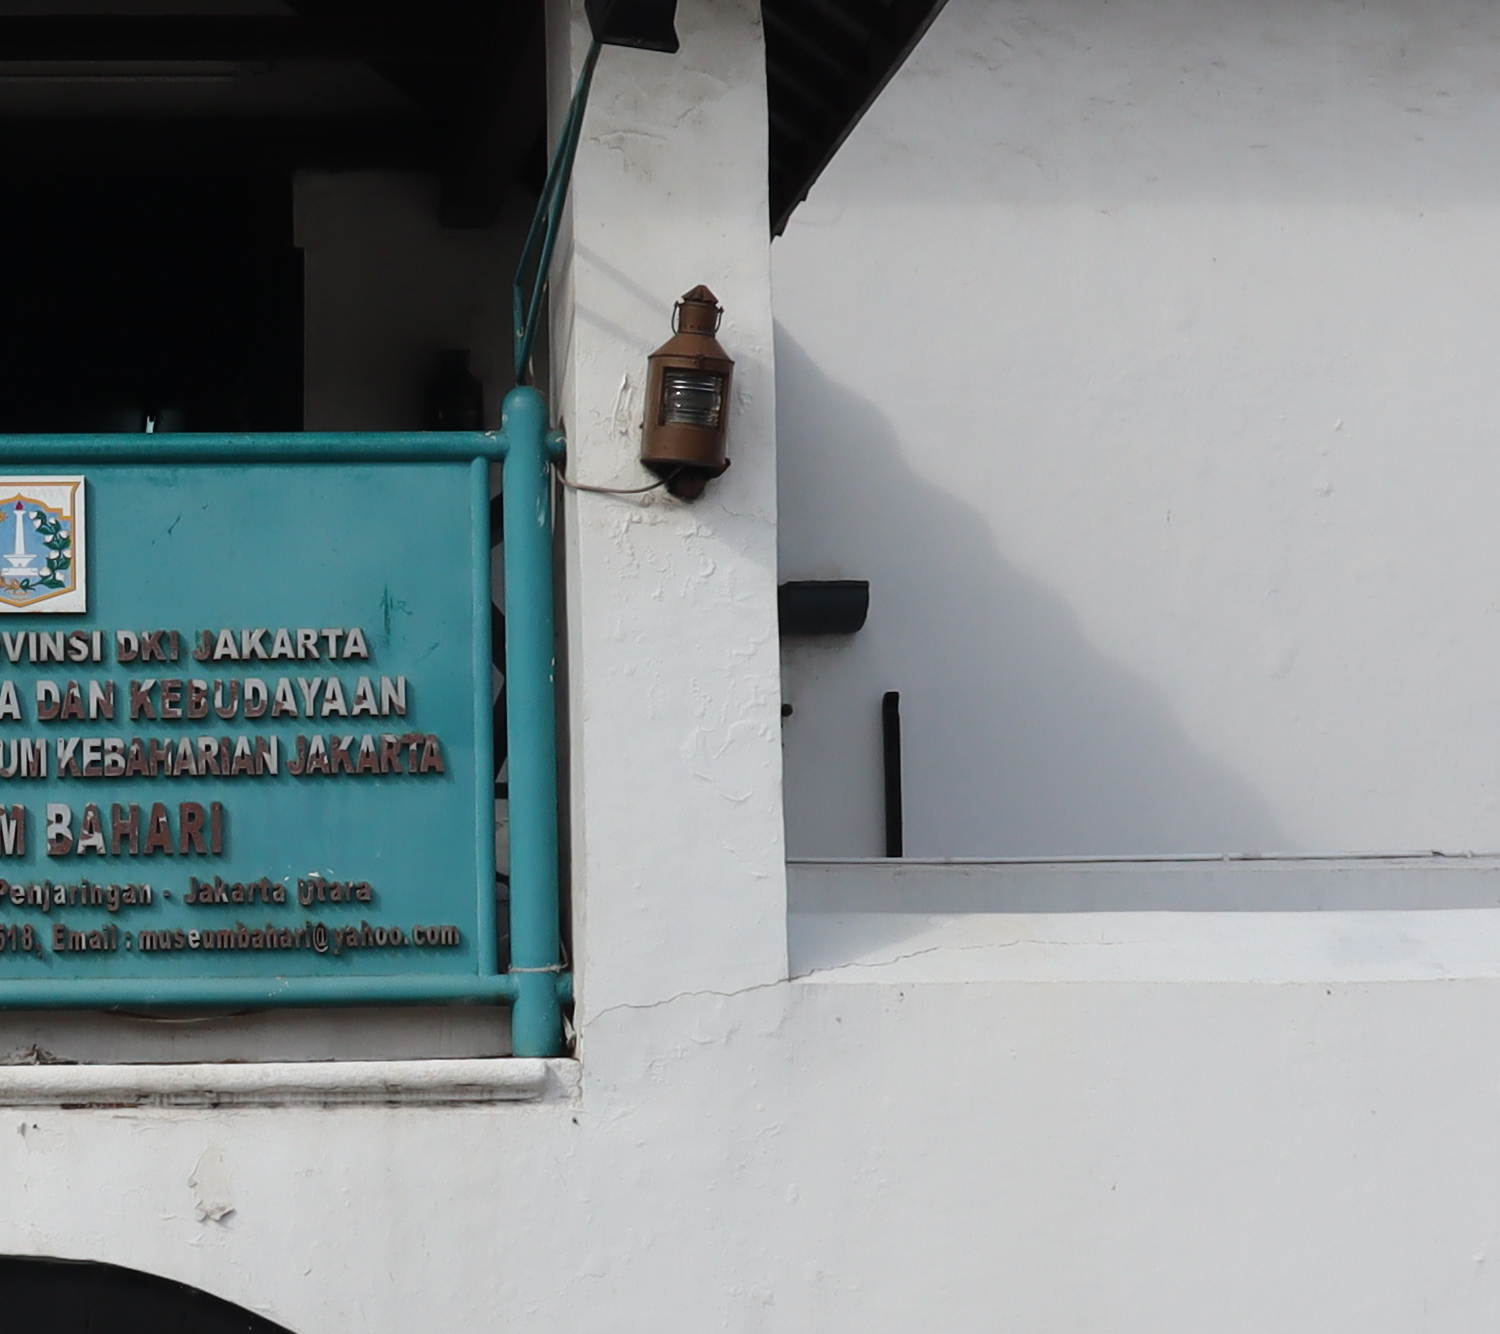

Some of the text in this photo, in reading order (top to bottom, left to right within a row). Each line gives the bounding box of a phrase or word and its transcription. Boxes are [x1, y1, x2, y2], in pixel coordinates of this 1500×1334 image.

[117, 630, 178, 662] DKI
[193, 627, 370, 661] JAKARTA
[37, 680, 113, 720] DAN
[130, 676, 407, 720] KEBUDAYAAN
[57, 735, 280, 778] KEBAHARIAN
[287, 732, 445, 775] JAKARTA
[47, 801, 223, 856] BAHARI
[183, 877, 286, 904] Jakarta
[52, 923, 118, 952] Email
